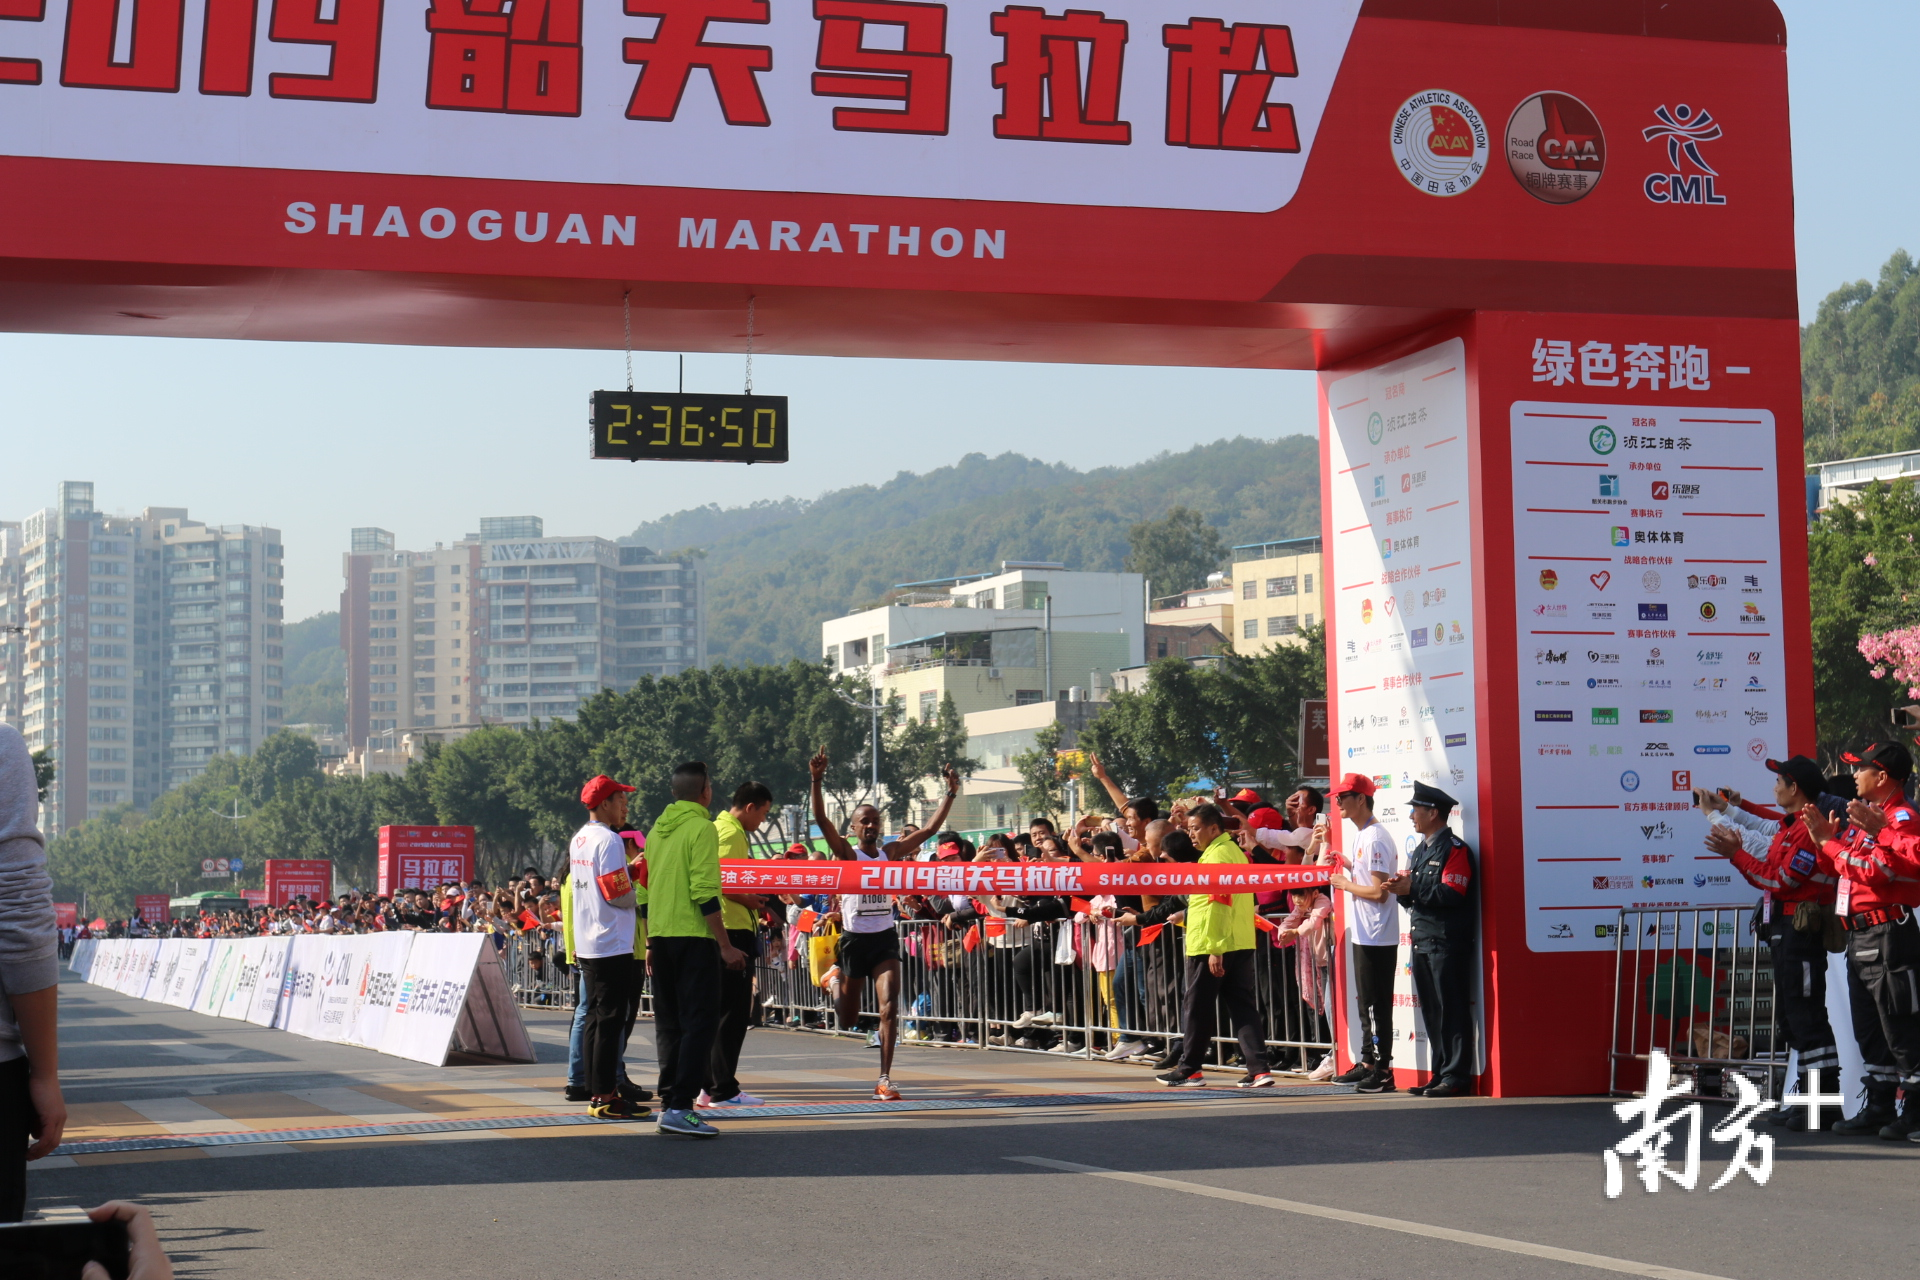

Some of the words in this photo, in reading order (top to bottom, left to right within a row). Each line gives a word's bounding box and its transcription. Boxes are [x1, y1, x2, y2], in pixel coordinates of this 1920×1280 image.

[0, 0, 1300, 153] 019韶关马拉松
[1393, 107, 1412, 145] CHINESE
[1409, 92, 1451, 111] ATHLETICS
[1452, 98, 1486, 149] ASSOCIATION
[1510, 137, 1535, 148] Road
[1544, 139, 1600, 162] CAA
[1510, 150, 1535, 161] Race
[1400, 158, 1483, 194] 中国田径协会
[1525, 170, 1589, 191] 铜牌赛事
[1643, 172, 1727, 205] CML
[284, 201, 637, 246] SHAOGUAN
[678, 217, 1006, 259] MARATHON
[1531, 338, 1711, 391] 绿色奔跑
[1385, 382, 1406, 400] 冠名商
[607, 404, 776, 448] 2:36:50
[1631, 417, 1656, 427] 冠名商
[1623, 435, 1692, 451] 浈江油茶
[1384, 445, 1411, 464] 承办单位
[1629, 462, 1662, 471] 承办单位
[1672, 483, 1701, 494] 乐跑客
[1386, 507, 1413, 526] 赛事执行
[1630, 509, 1663, 518] 赛事执行
[1634, 531, 1684, 544] 奥体体育
[1623, 555, 1673, 566] 战略合作伙伴
[1381, 564, 1421, 585] 战略合作伙伴
[1627, 629, 1677, 639] 赛事合作伙伴
[1382, 672, 1422, 691] 赛事合作伙伴
[1675, 771, 1687, 785] G
[1624, 802, 1690, 812] 官方赛事法律顾问
[204, 861, 213, 869] 60
[1641, 854, 1675, 863] 赛事推广
[403, 859, 459, 877] 马拉松
[720, 870, 834, 886] 油茶产业园特约
[860, 866, 1084, 892] 2019韶关马拉松
[1098, 874, 1210, 886] SHAOGUAN
[1218, 871, 1329, 886] MARATHON
